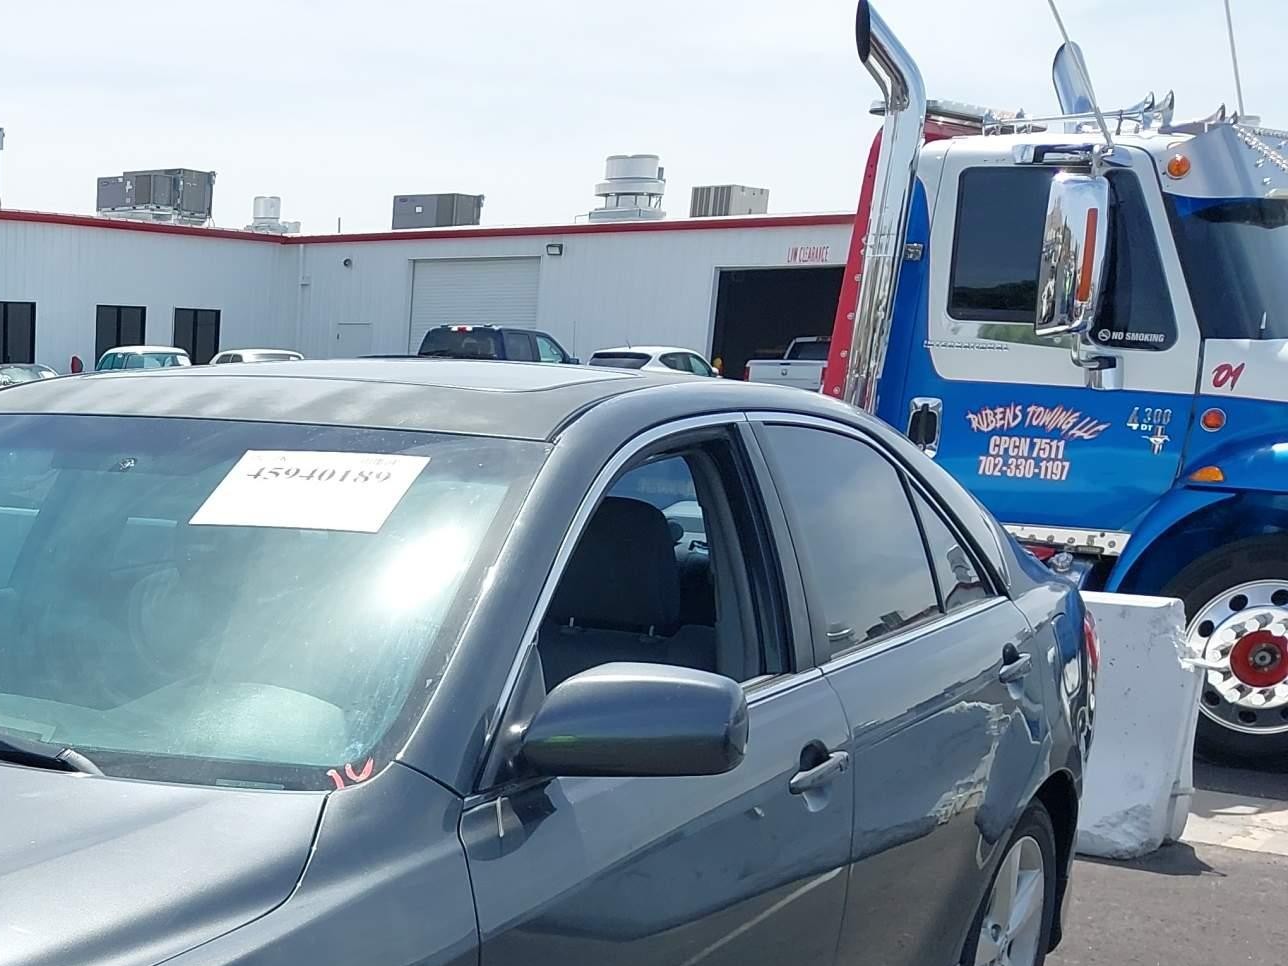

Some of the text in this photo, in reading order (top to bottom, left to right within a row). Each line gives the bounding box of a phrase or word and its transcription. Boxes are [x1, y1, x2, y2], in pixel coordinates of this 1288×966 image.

[799, 246, 829, 262] CLEARANCE
[1112, 330, 1165, 343] NO SMOKING
[965, 402, 1112, 440] RUBENS TOWING LLC
[989, 436, 1066, 459] CPCN 7511
[247, 466, 392, 483] 45940189
[978, 456, 1070, 480] 702-330-1197
